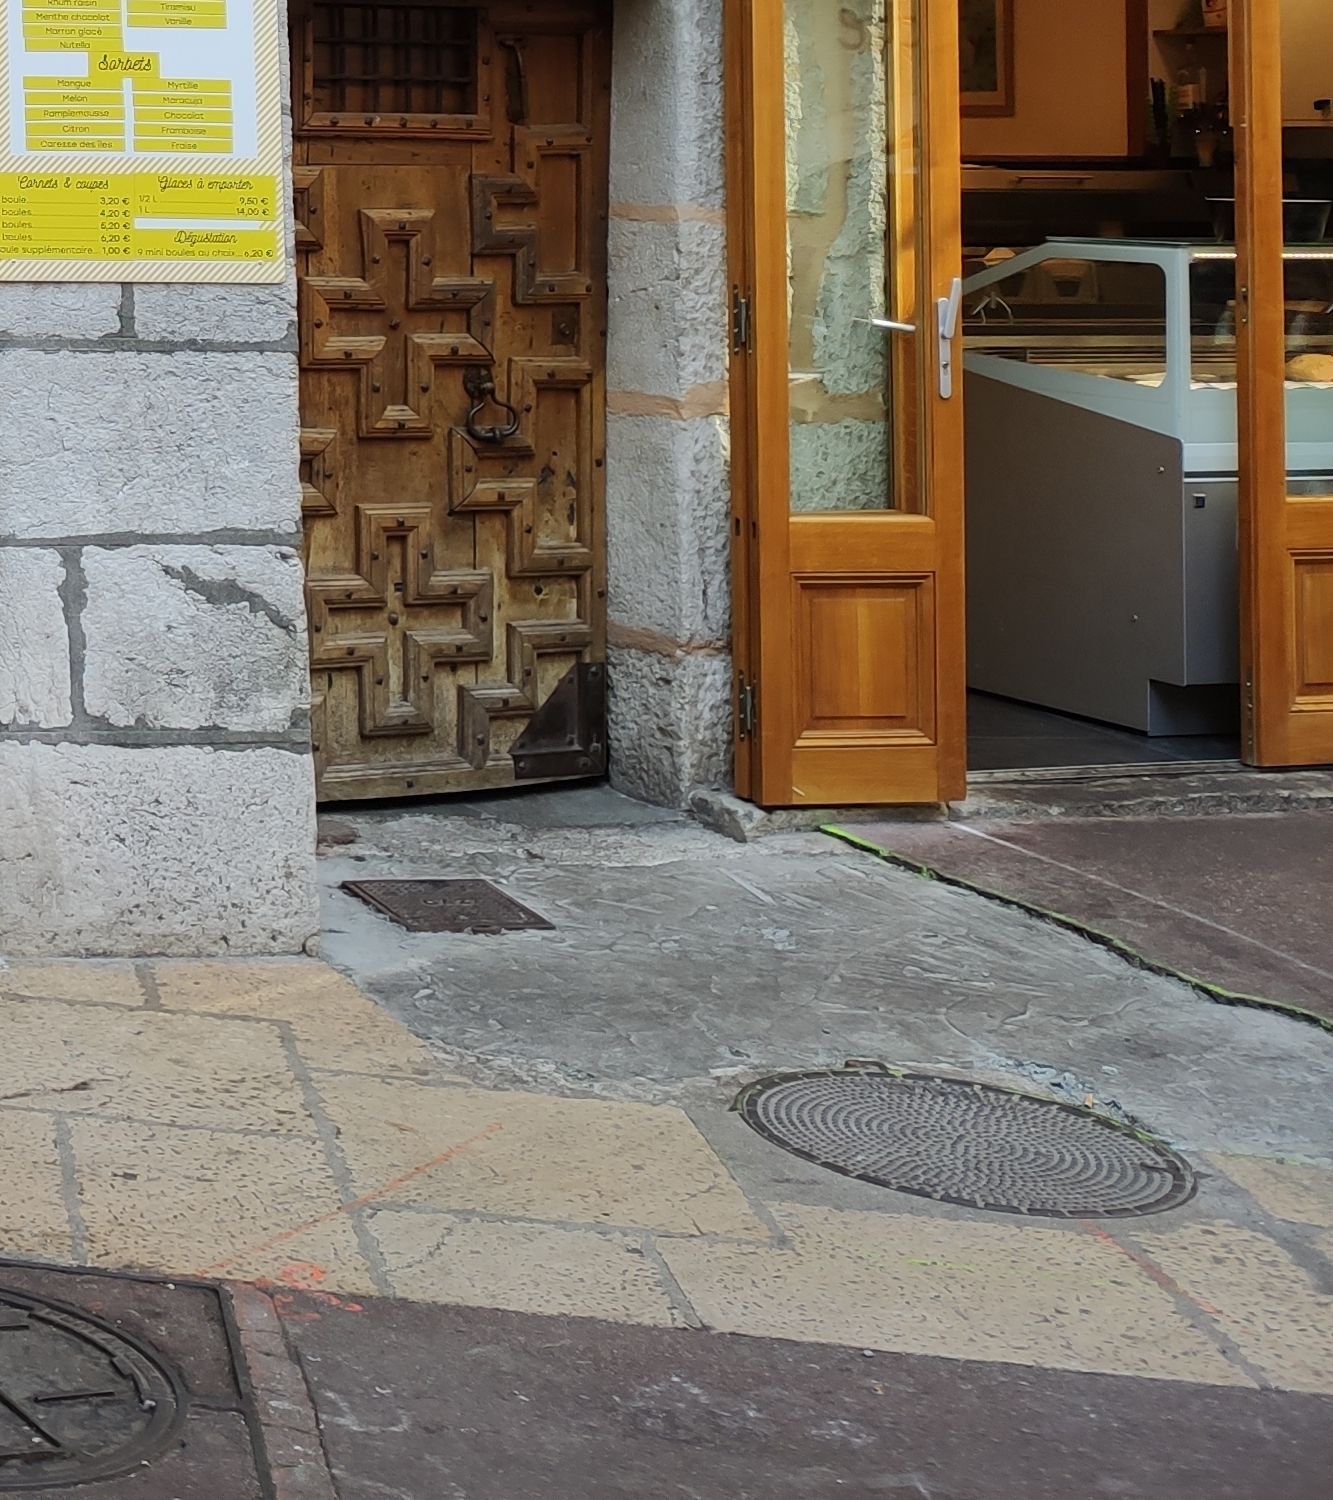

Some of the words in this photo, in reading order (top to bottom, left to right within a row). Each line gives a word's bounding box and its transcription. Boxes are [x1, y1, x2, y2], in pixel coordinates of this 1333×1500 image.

[98, 54, 152, 72] Sorbets
[18, 175, 59, 190] Cornets
[75, 178, 109, 193] coupes
[157, 175, 193, 193] Glaces
[206, 177, 253, 193] emporter
[173, 230, 238, 247] Dégustation
